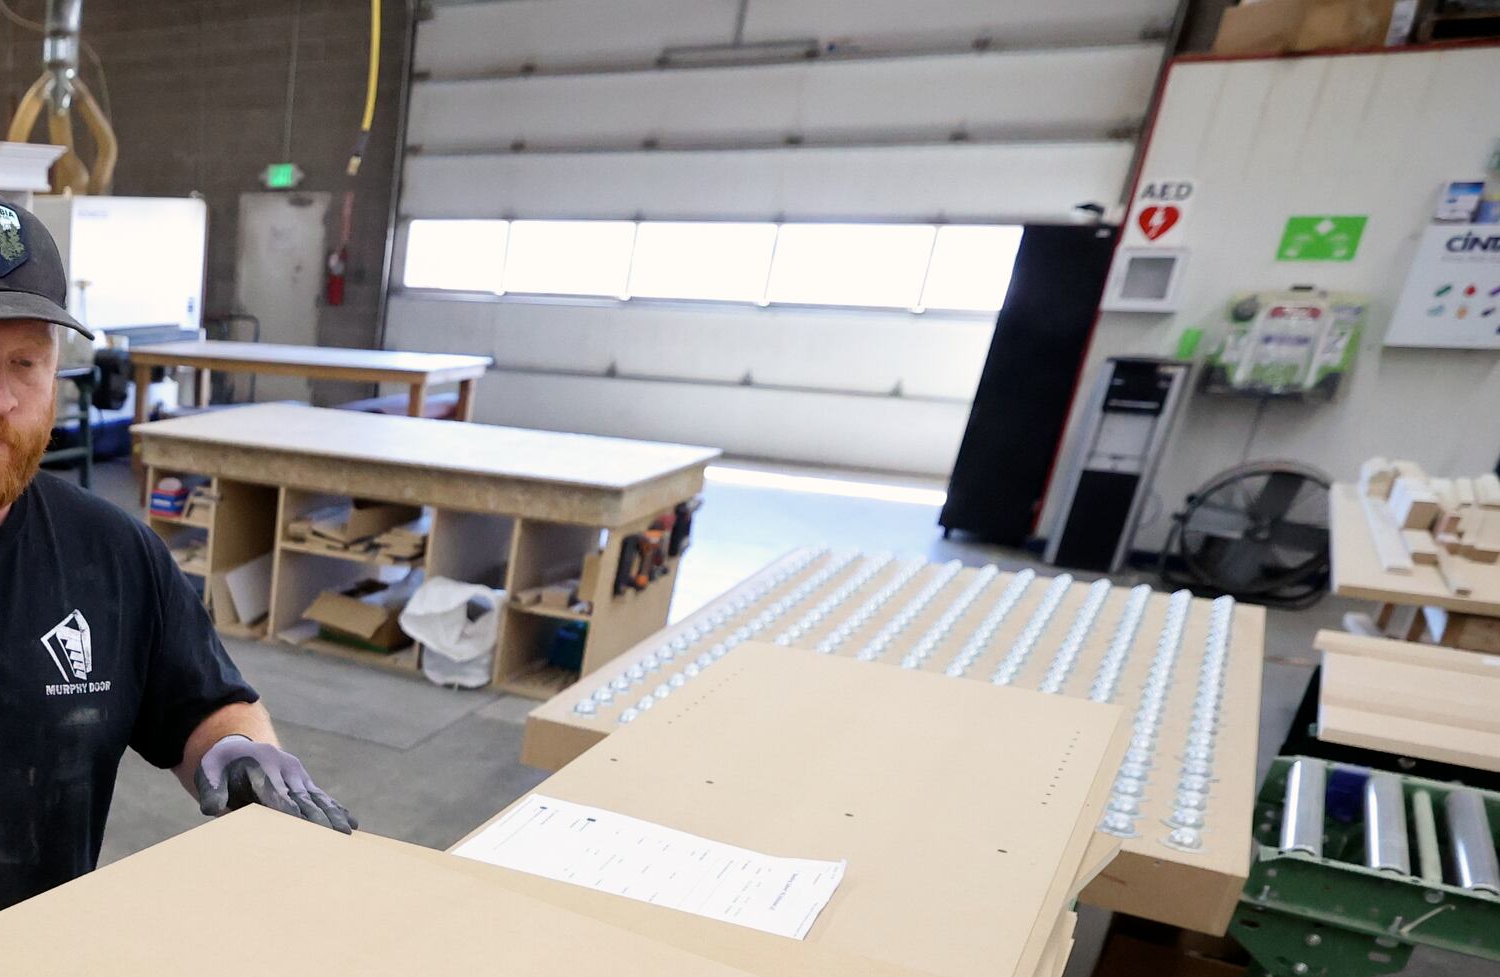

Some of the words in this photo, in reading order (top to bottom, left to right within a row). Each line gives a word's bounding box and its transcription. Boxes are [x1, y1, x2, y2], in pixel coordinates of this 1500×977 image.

[1141, 183, 1194, 200] AED
[45, 683, 88, 695] MURPHY
[88, 681, 111, 693] DOOR
